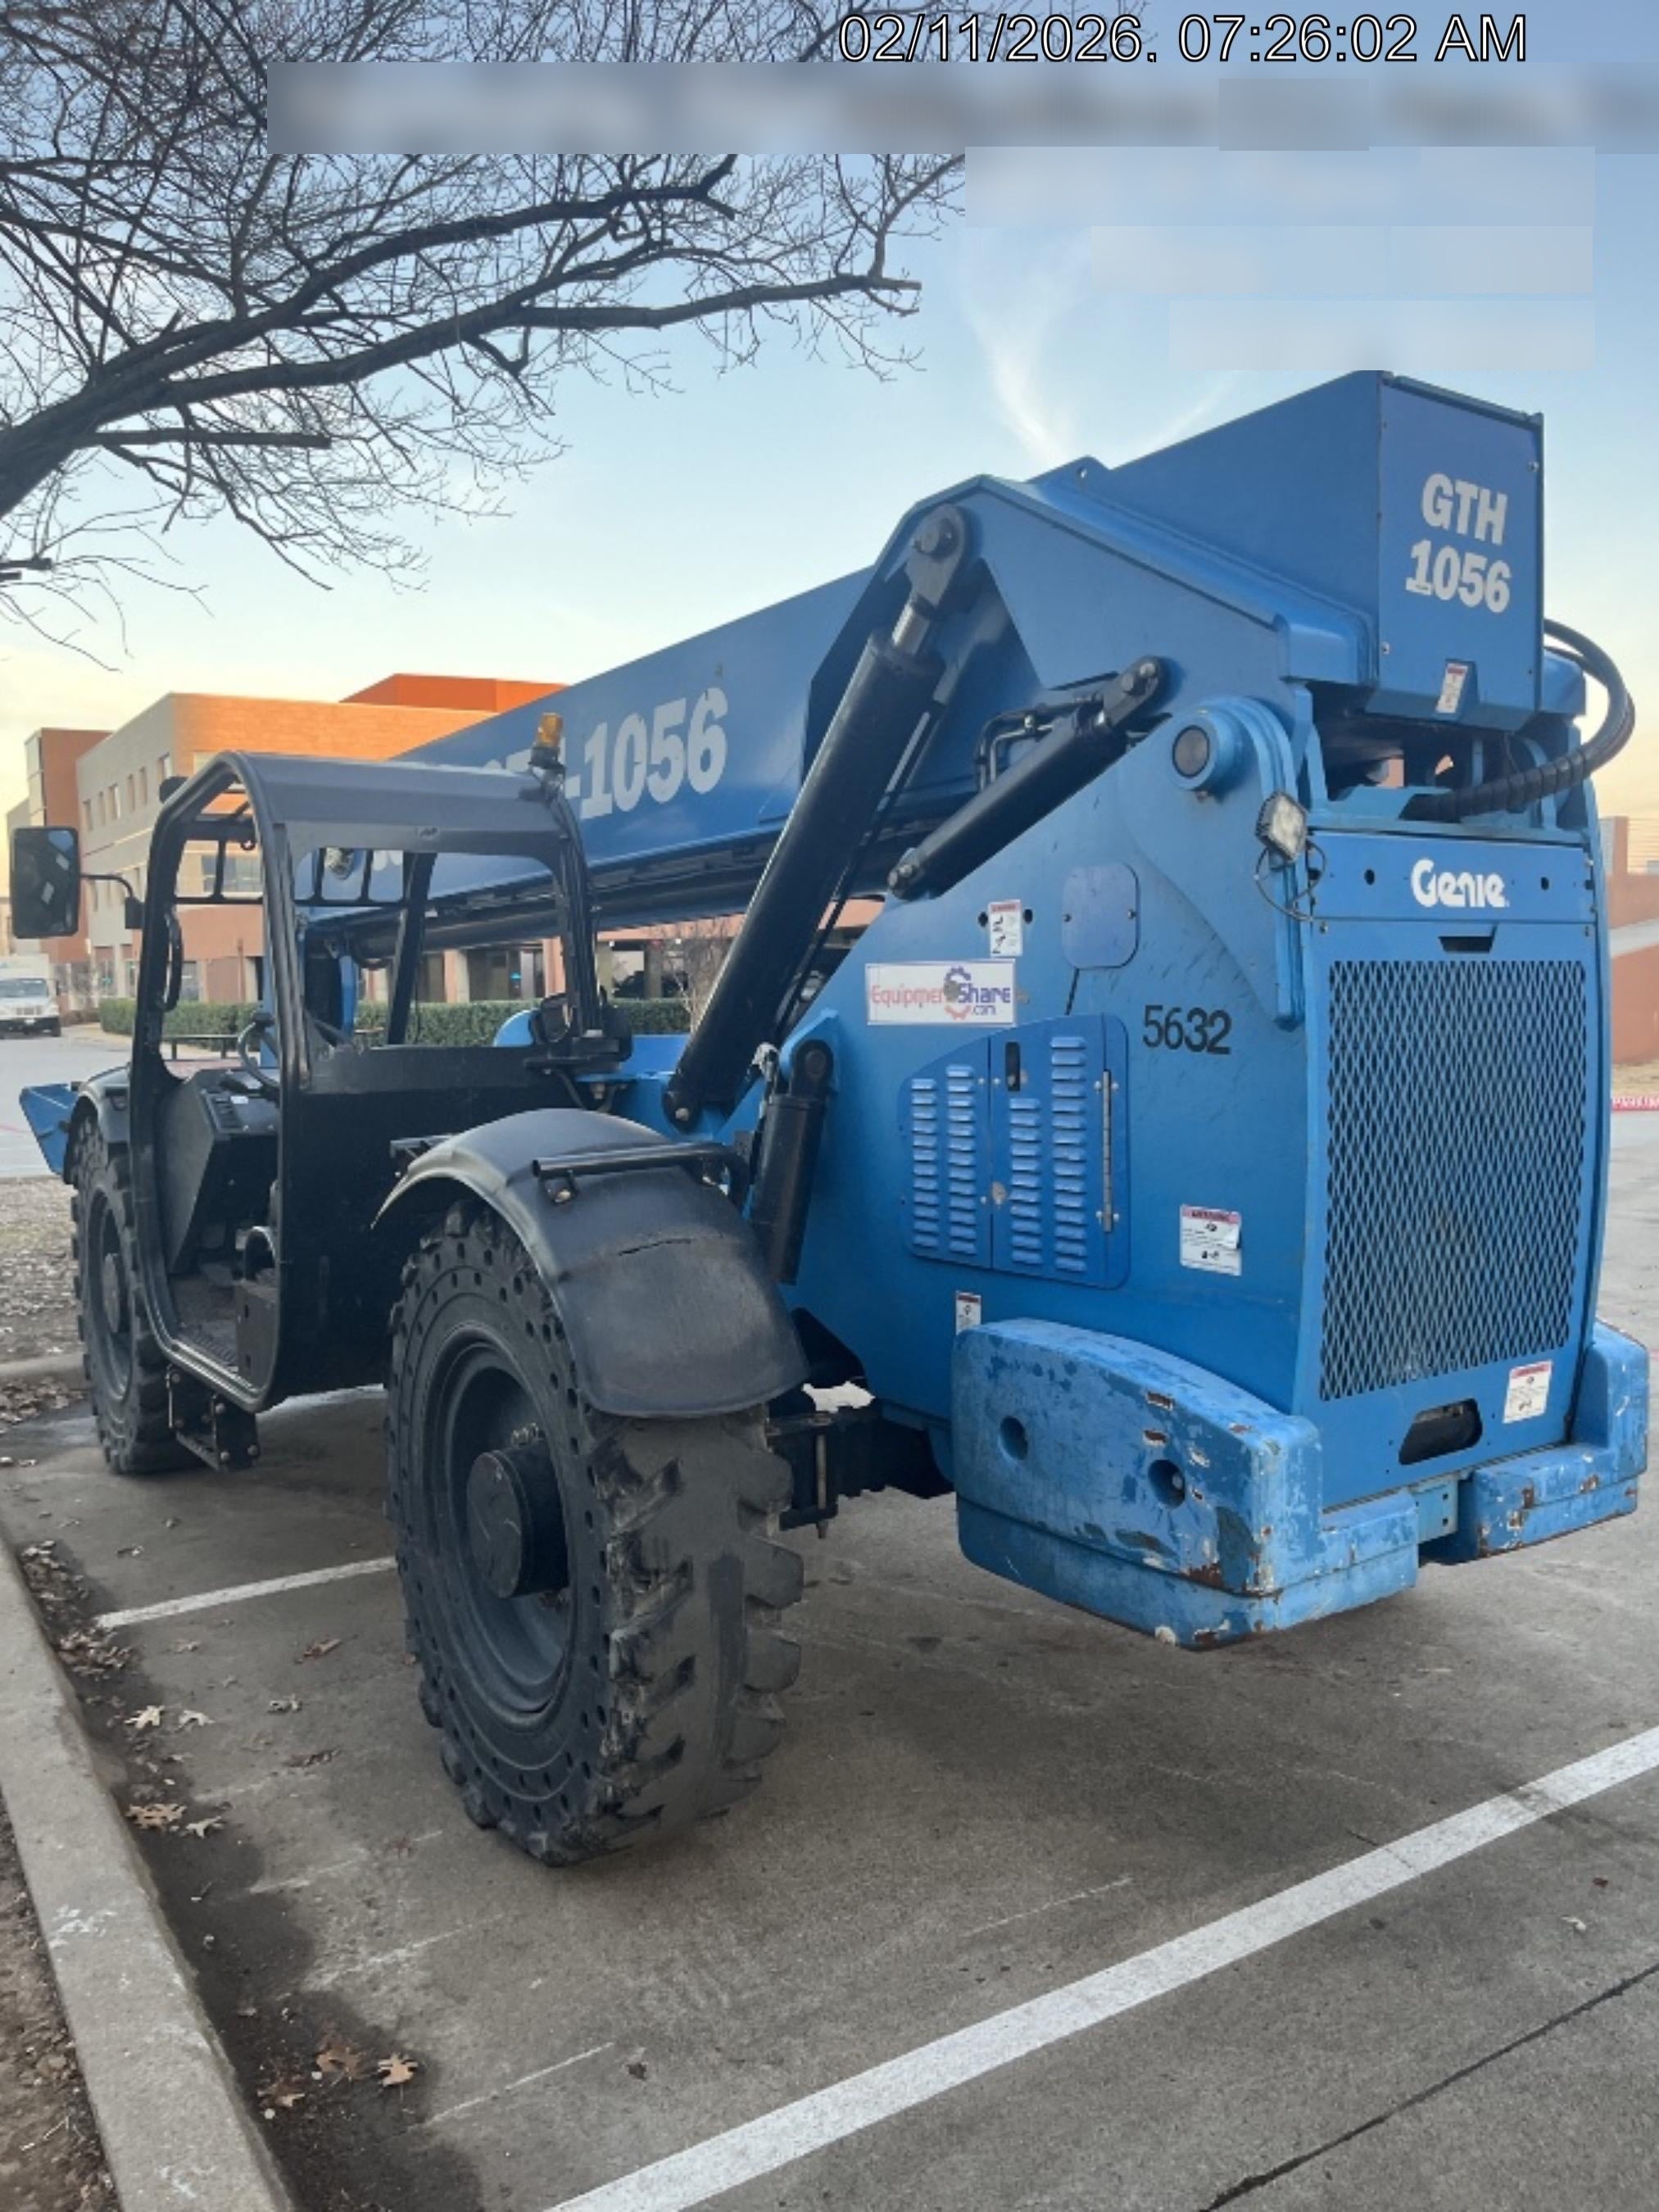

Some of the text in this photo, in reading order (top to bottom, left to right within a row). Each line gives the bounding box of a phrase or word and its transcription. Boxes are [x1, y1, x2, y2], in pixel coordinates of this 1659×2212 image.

[1421, 473, 1507, 546] GTH
[1405, 538, 1512, 613] 1056
[484, 687, 728, 819] -1056
[1411, 858, 1506, 908] Genie
[1142, 1004, 1232, 1055] 5632
